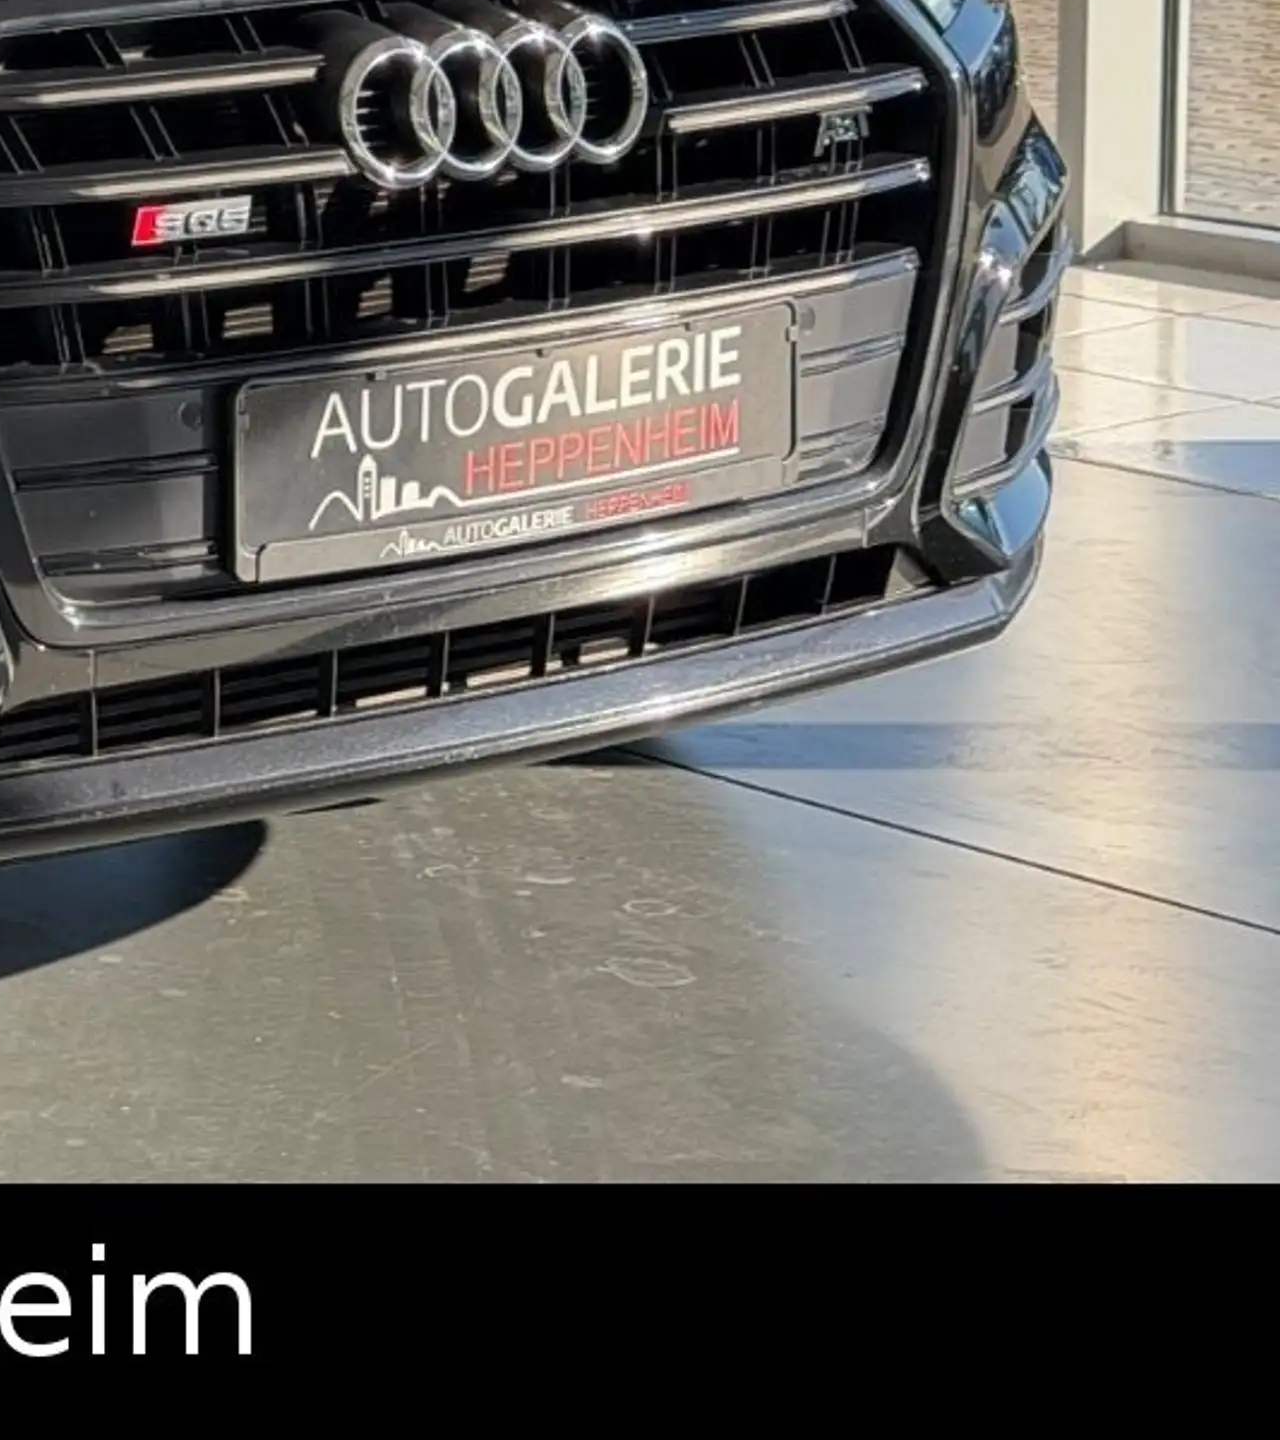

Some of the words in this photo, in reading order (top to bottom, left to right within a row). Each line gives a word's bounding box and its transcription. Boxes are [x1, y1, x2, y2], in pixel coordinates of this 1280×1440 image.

[149, 200, 252, 242] SQ5
[310, 326, 741, 458] AUTOGALERIE
[465, 398, 740, 495] HEPPENHEIM
[444, 506, 574, 545] AUTOGALERIE
